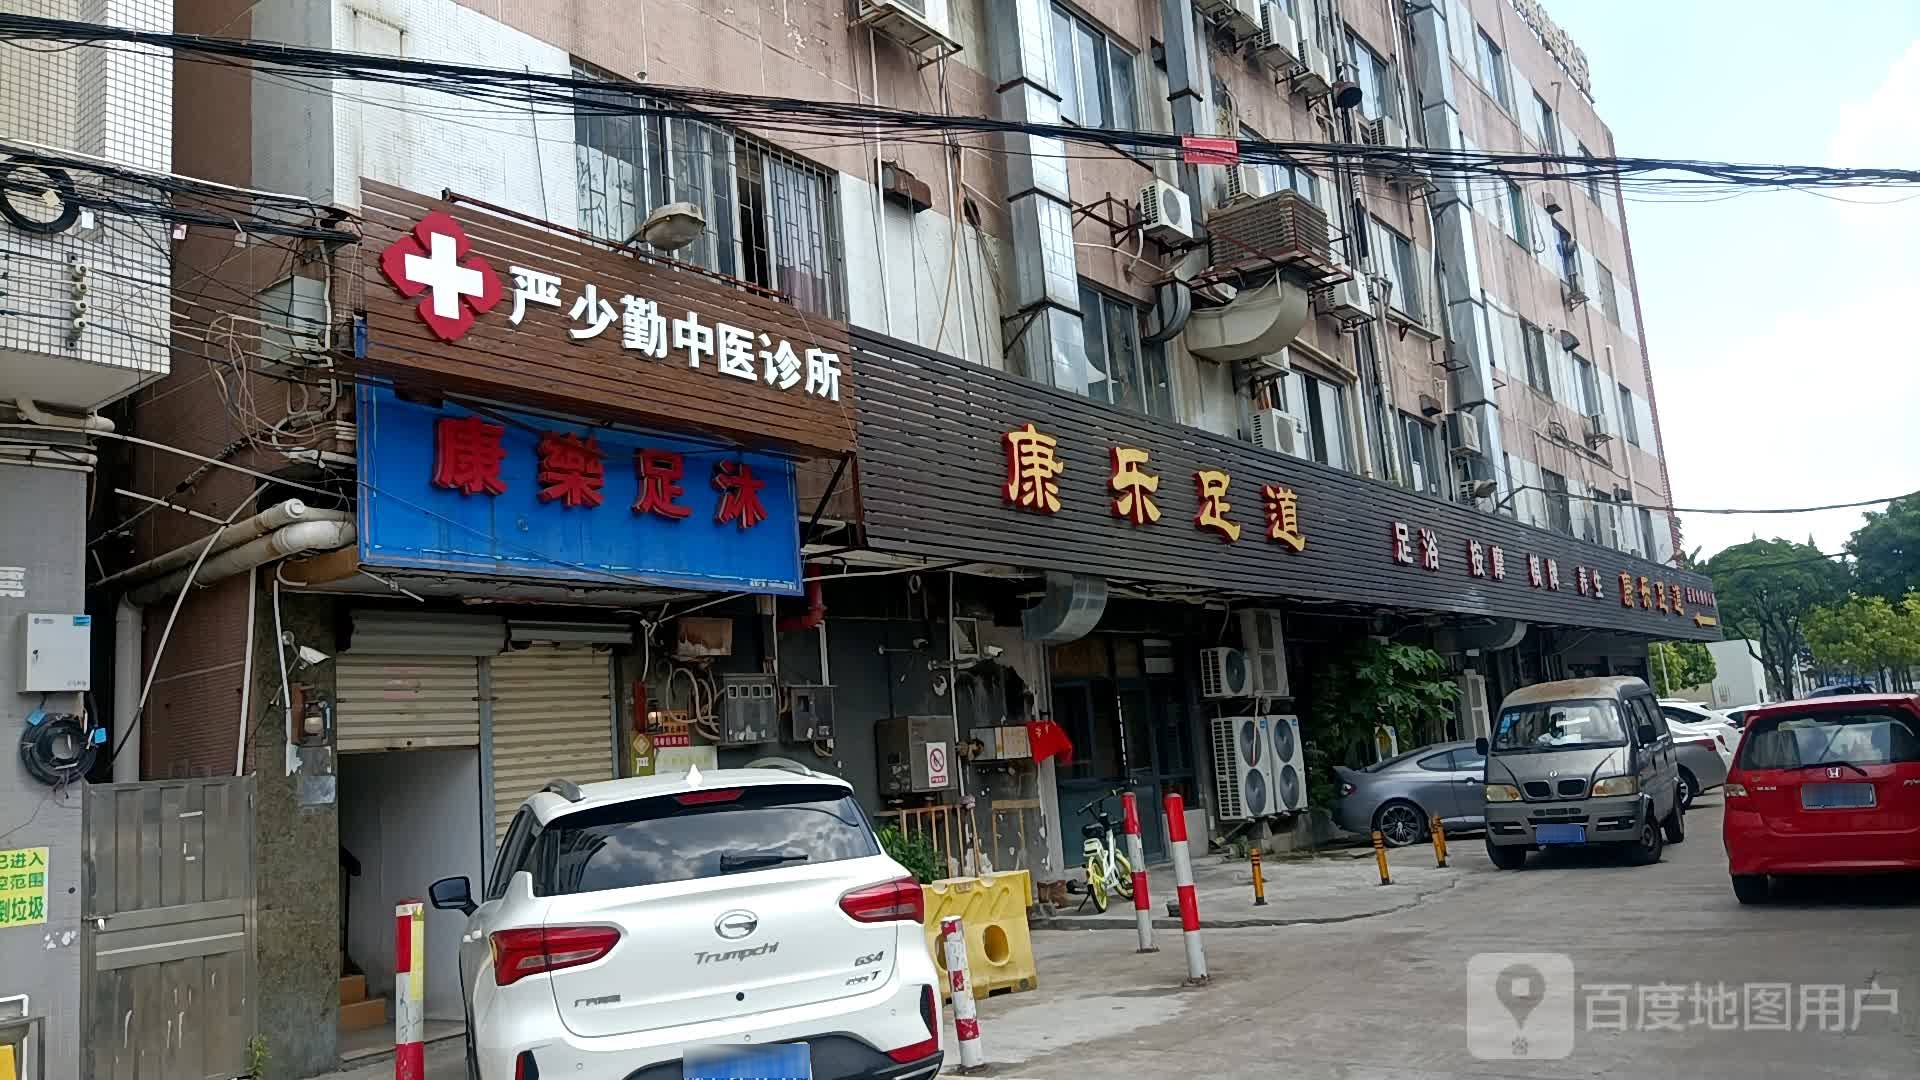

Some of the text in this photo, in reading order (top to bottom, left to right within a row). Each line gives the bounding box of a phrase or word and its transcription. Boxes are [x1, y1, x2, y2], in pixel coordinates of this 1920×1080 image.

[509, 265, 843, 402] 严少勤中医诊所
[1002, 423, 1307, 553] 康乐足道
[1392, 520, 1440, 571] 足浴
[1466, 538, 1506, 581] 按摩
[1575, 564, 1605, 599] 养生
[694, 941, 780, 966] Trumpchi
[854, 951, 884, 967] GS4
